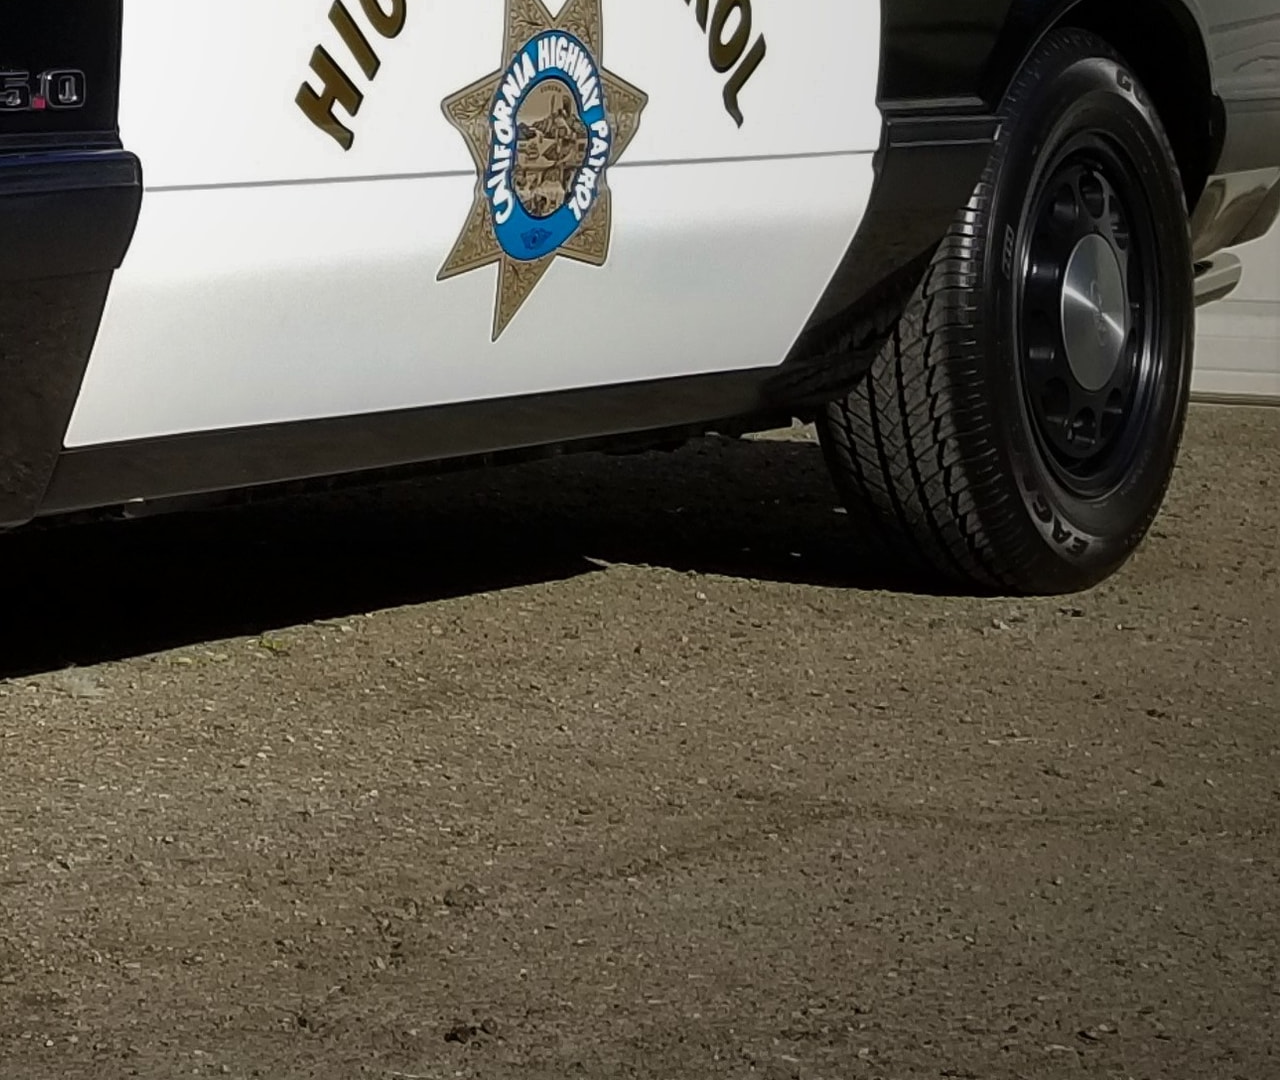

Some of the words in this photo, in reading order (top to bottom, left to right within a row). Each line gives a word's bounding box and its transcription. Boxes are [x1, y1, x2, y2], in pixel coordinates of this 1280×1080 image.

[538, 36, 600, 112] HIGHWAY
[487, 51, 537, 225] CALIFORNIA
[568, 120, 609, 221] PATROL
